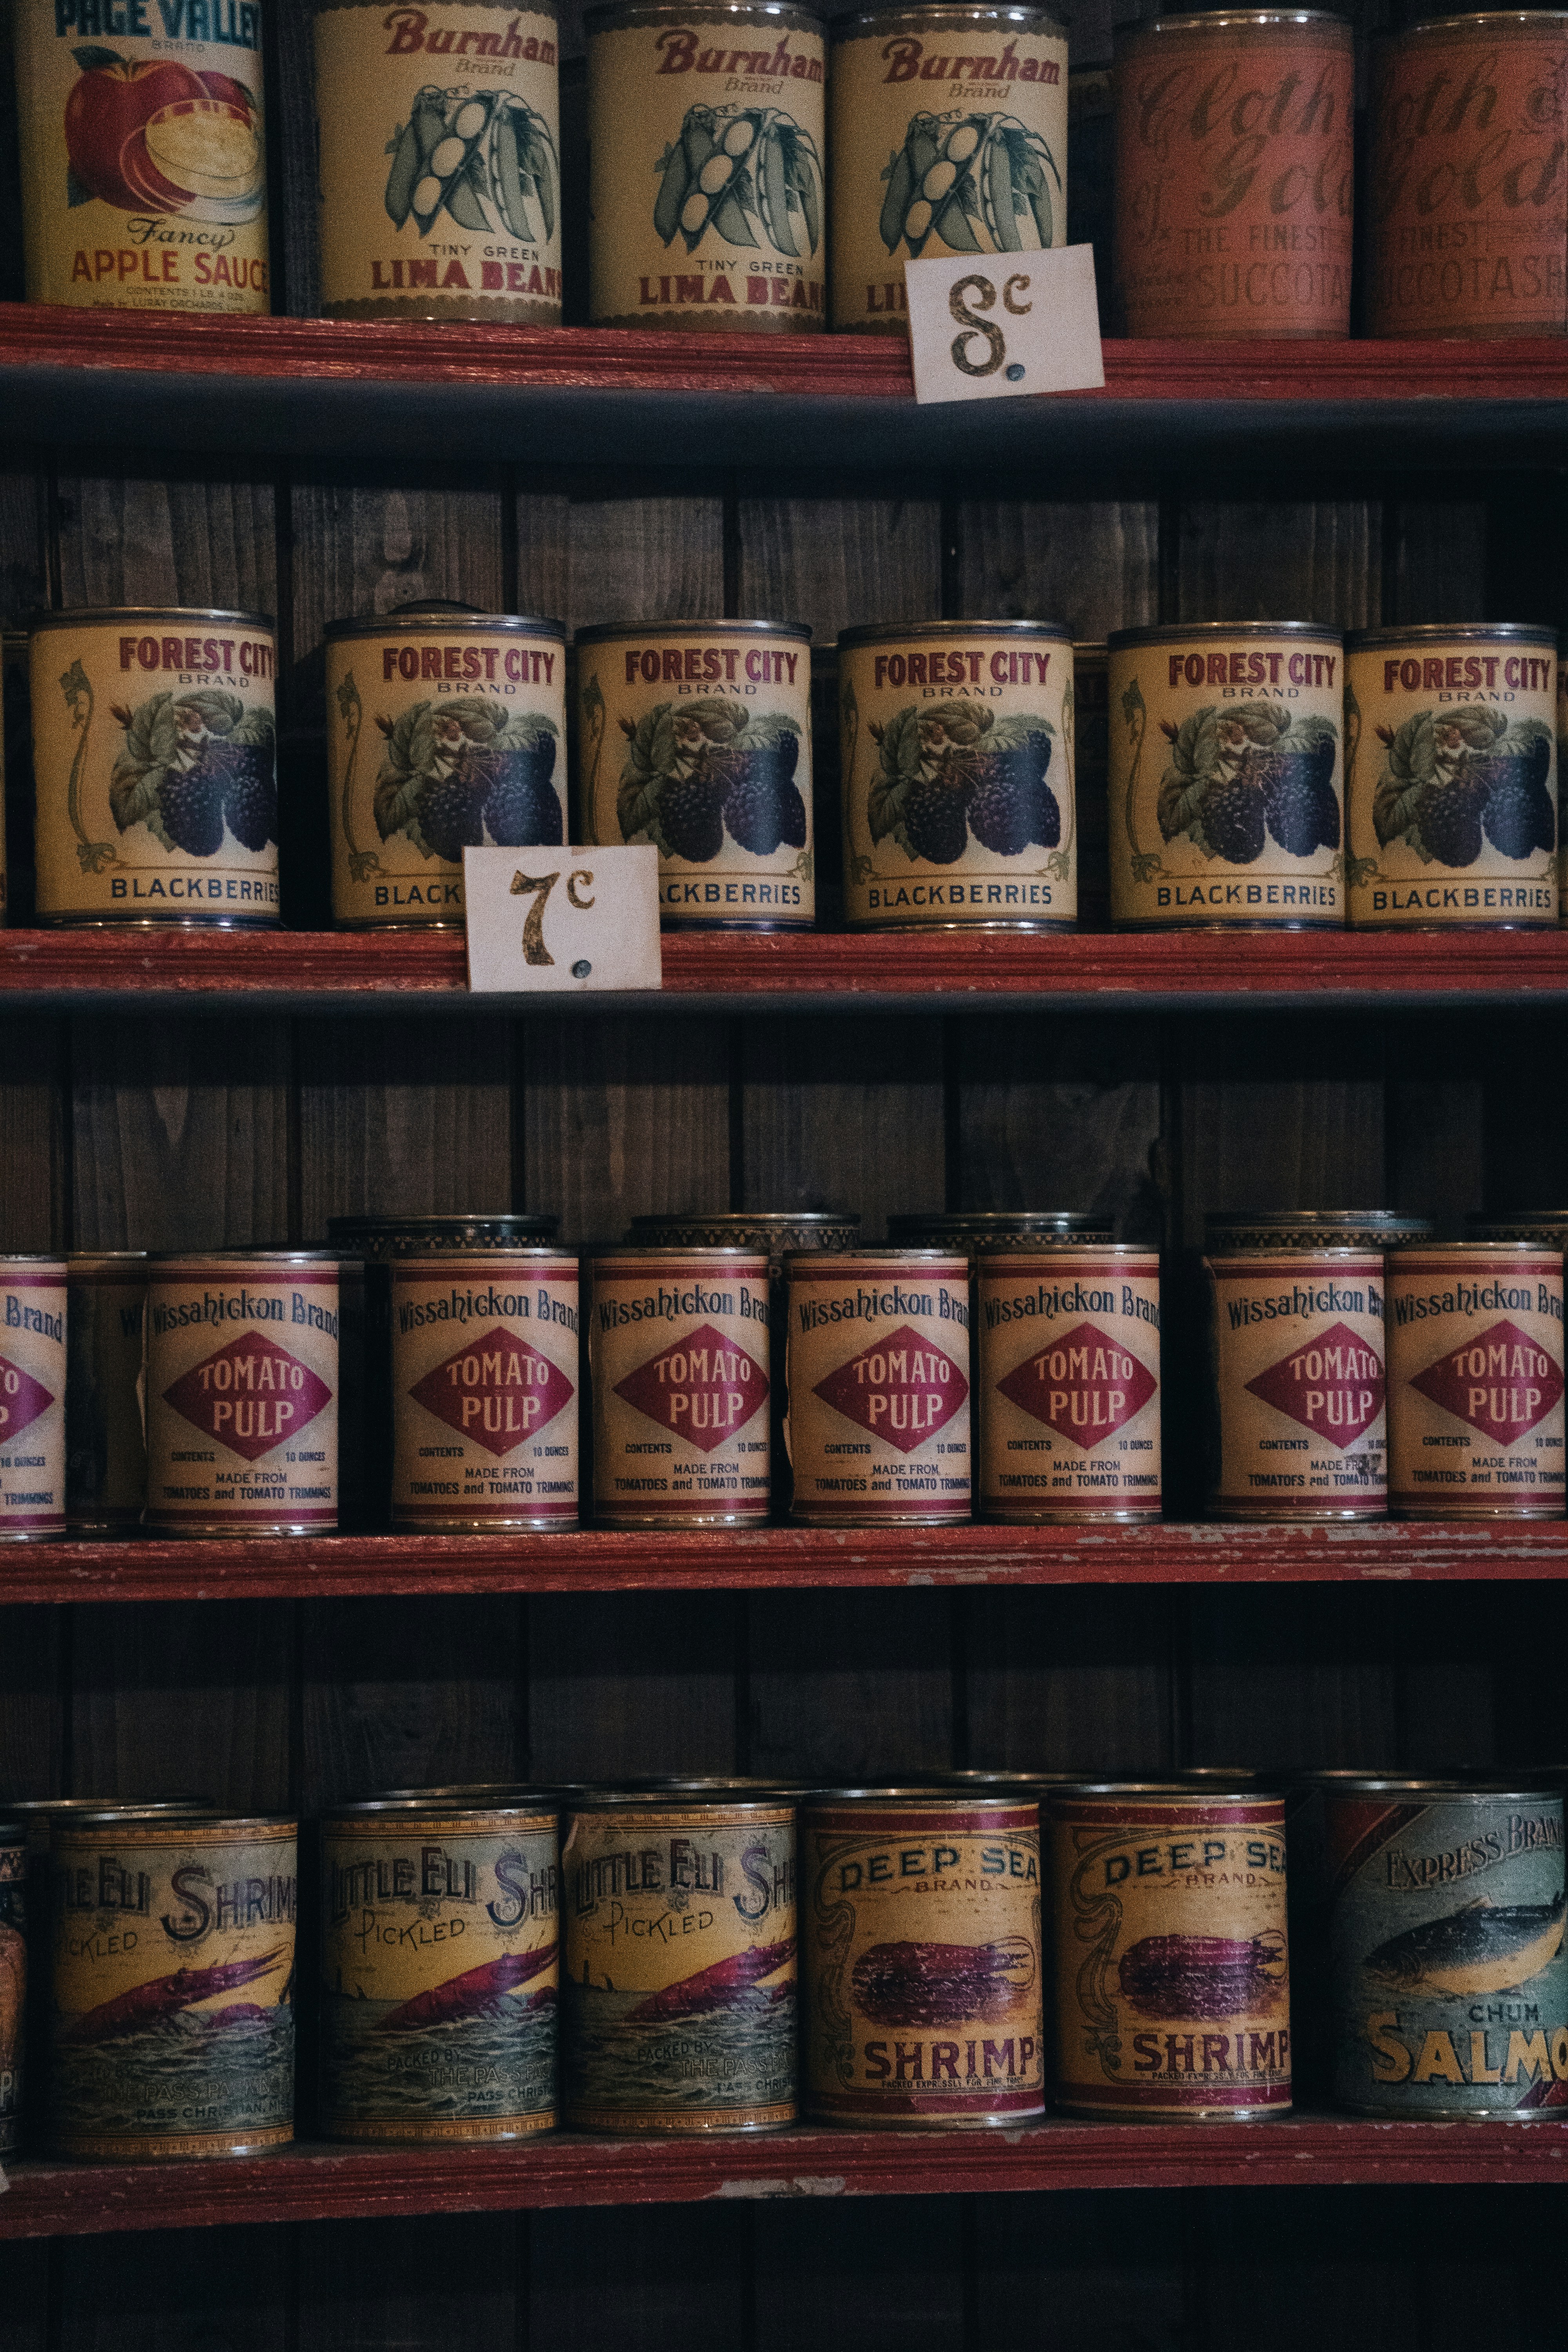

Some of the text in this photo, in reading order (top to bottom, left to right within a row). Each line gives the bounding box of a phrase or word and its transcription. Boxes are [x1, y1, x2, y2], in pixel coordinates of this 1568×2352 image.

[151, 40, 205, 53] BRAND
[383, 8, 556, 65] Burnham
[455, 58, 516, 77] Brand
[655, 29, 824, 83] Burnham
[882, 38, 1061, 85] Burnham
[724, 77, 784, 95] Brand
[948, 83, 1011, 99] Brand
[127, 218, 235, 252] Fancy
[1182, 223, 1328, 254] THE FINEST
[72, 249, 180, 282] APPLE
[429, 244, 539, 261] TINY GREEN
[695, 260, 804, 276] TINY GREEN
[370, 260, 472, 290] LIMA
[639, 275, 737, 305] LIMA
[119, 636, 235, 673] FOREST
[383, 647, 555, 683] FOREST CITY
[625, 648, 799, 684] FOREST CITY
[875, 651, 1051, 687] FOREST CITY
[1168, 652, 1336, 687] FOREST CITY
[178, 673, 249, 688] BRAND
[437, 682, 517, 695] BRAND
[1384, 656, 1551, 691] FOREST CITY
[678, 684, 757, 695] BRAND
[923, 686, 1004, 698] BRAND
[1222, 688, 1300, 699] BRAND
[1439, 691, 1515, 702] BRAND
[111, 878, 279, 904] BLACKBERRIES
[868, 884, 1053, 909] BLACKBERRIES
[1157, 884, 1336, 906] BLACKBERRIES
[1373, 888, 1551, 910] BLACKBERRIES
[5, 1294, 62, 1344] Brand
[398, 1286, 530, 1334] Wissahickon
[599, 1284, 735, 1332] Wissahickon
[799, 1285, 933, 1333] Wissahickon
[984, 1283, 1115, 1330] Wissahickon
[1228, 1283, 1363, 1331] Wissahickon
[1394, 1280, 1532, 1327] Wissahickon
[198, 1355, 305, 1391] TOMATO
[446, 1351, 550, 1387] TOMATO
[653, 1348, 751, 1384] TOMATO
[852, 1349, 950, 1385] TOMATO
[1034, 1345, 1133, 1381] TOMATO
[1289, 1346, 1377, 1381] TOMATO
[1452, 1343, 1548, 1378] TOMATO
[212, 1400, 295, 1438] PULP
[461, 1396, 541, 1433] PULP
[670, 1392, 744, 1429] PULP
[867, 1394, 944, 1430] PULP
[1049, 1390, 1125, 1427] PULP
[1305, 1390, 1373, 1426] PULP
[1468, 1387, 1541, 1423] PULP
[171, 1451, 214, 1463] CONTENTS
[419, 1446, 464, 1457] CONTENTS
[625, 1443, 672, 1454] CONTENTS
[824, 1444, 871, 1454] CONTENTS
[1007, 1440, 1052, 1451] CONTENTS
[1259, 1439, 1309, 1450] CONTENTS
[1423, 1436, 1470, 1447] CONTENTS
[216, 1472, 288, 1483] MADE FROM
[465, 1467, 535, 1478] MADE FROM
[673, 1463, 739, 1474] MADE FROM
[873, 1465, 939, 1475] MADE FROM
[1053, 1461, 1121, 1471] MADE FROM
[1310, 1461, 1342, 1470] MADE
[1412, 1470, 1536, 1483] TOMATOES and TOMATO
[1472, 1457, 1537, 1468] MADE FROM
[215, 1487, 235, 1499] and
[240, 1487, 285, 1500] TOMATO
[410, 1481, 532, 1495] TOMATOES and TOMATO
[614, 1477, 737, 1491] TOMATOES and TOMATO
[815, 1478, 937, 1492] TOMATOES and TOMATO
[998, 1474, 1118, 1487] TOMATOES and TOMATO
[841, 1847, 1040, 1893] DEEP SEA
[1105, 1841, 1226, 1886] DEEP
[1385, 1830, 1507, 1891] EXPRESS
[330, 1858, 414, 1925] LITTLE
[915, 1879, 993, 1894] BRAND
[354, 1908, 466, 1954] PICKLED
[603, 1900, 714, 1947] PICKLED
[1468, 2004, 1539, 2023] CHUM
[864, 2037, 1035, 2080] SHRIMP
[1133, 2030, 1289, 2072] SHRIMP
